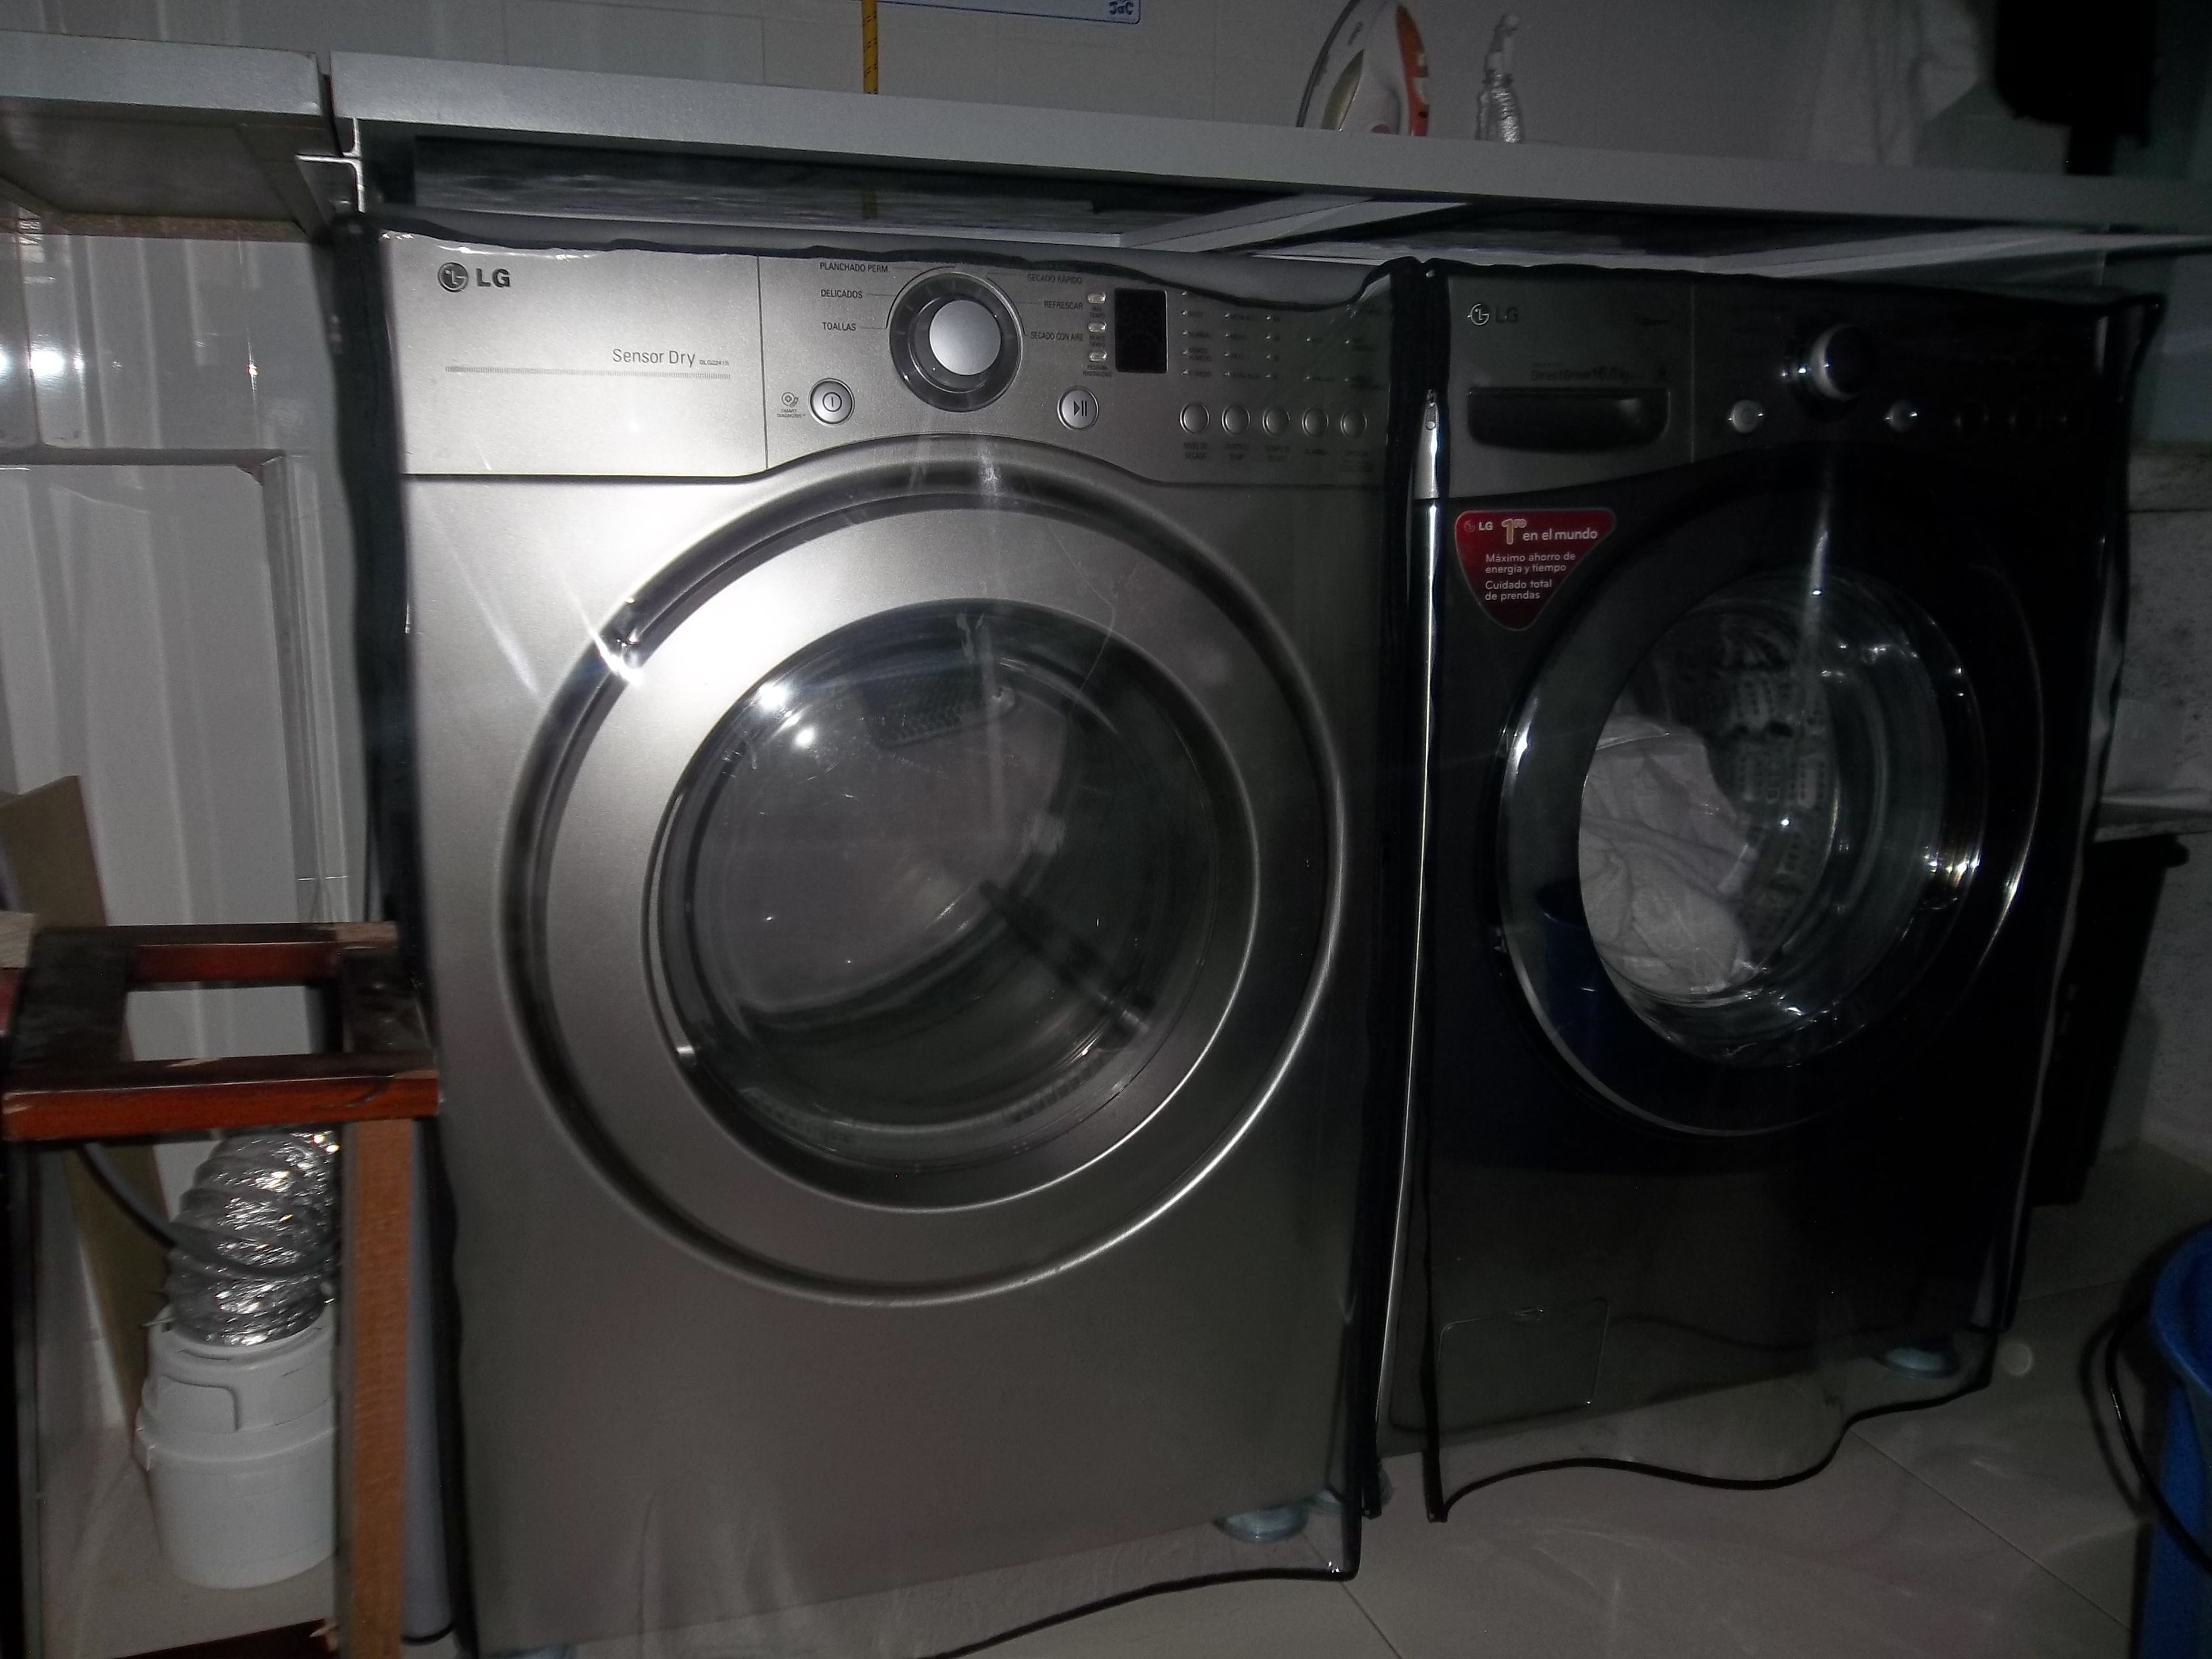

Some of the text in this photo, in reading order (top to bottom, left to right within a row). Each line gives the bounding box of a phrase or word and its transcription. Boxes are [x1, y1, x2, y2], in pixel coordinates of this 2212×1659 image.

[820, 262, 890, 273] PLANCHADO PERM.
[476, 267, 512, 287] LG
[821, 289, 862, 298] DELICADOS
[1044, 301, 1083, 309] REFRESCAR
[1495, 306, 1519, 323] LG
[822, 322, 856, 331] TOALLAS
[1031, 331, 1055, 340] SECADO
[1056, 332, 1070, 340] CON
[613, 349, 695, 368] Sensor Dry
[1479, 521, 1493, 531] LG
[1522, 531, 1537, 541] en
[1541, 528, 1552, 540] el
[1555, 527, 1599, 540] mundo
[1486, 551, 1576, 563] Máximo ahorro de
[1524, 566, 1529, 575] y
[1532, 563, 1567, 574] tiempo
[1485, 579, 1552, 590] Cuidado total
[1485, 590, 1540, 602] de prendas
